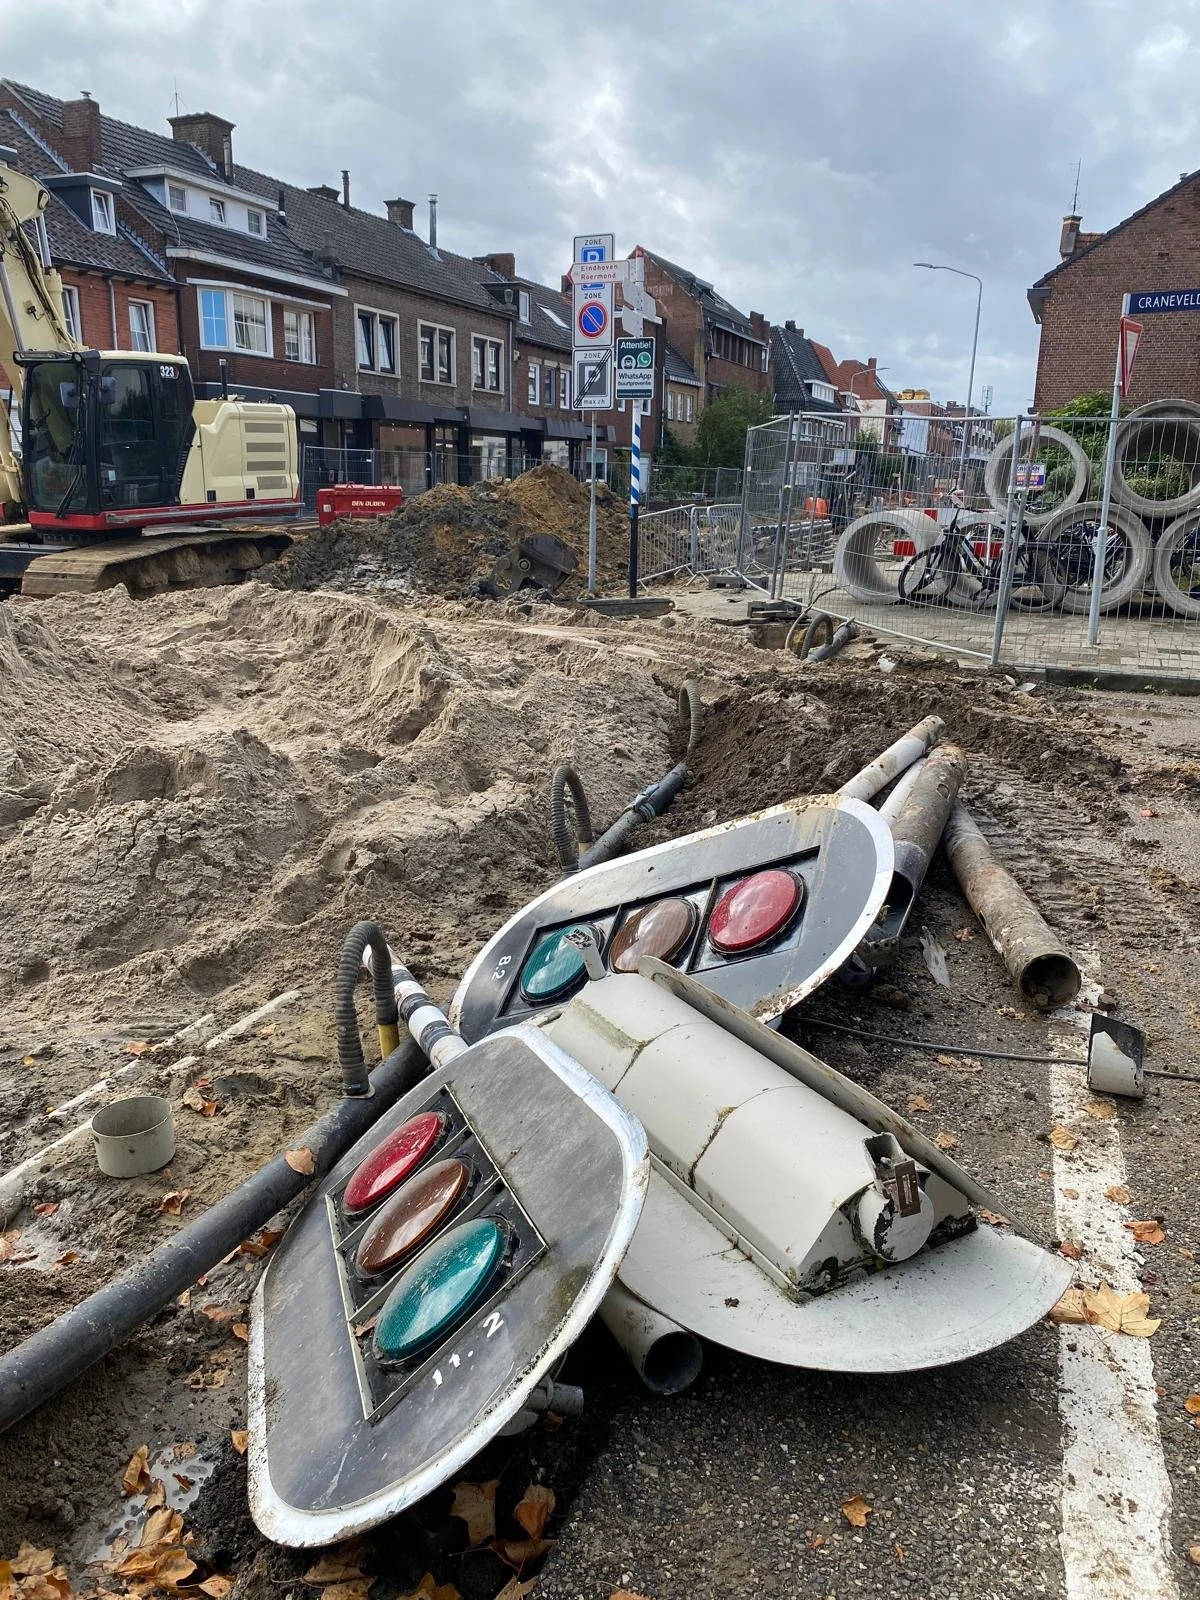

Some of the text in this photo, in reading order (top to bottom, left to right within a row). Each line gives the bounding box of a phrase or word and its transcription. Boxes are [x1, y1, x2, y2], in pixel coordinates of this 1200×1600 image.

[580, 264, 618, 272] Eindhoven
[620, 341, 652, 349] Attentie!
[160, 366, 175, 377] 323
[618, 372, 652, 380] WhatsApp
